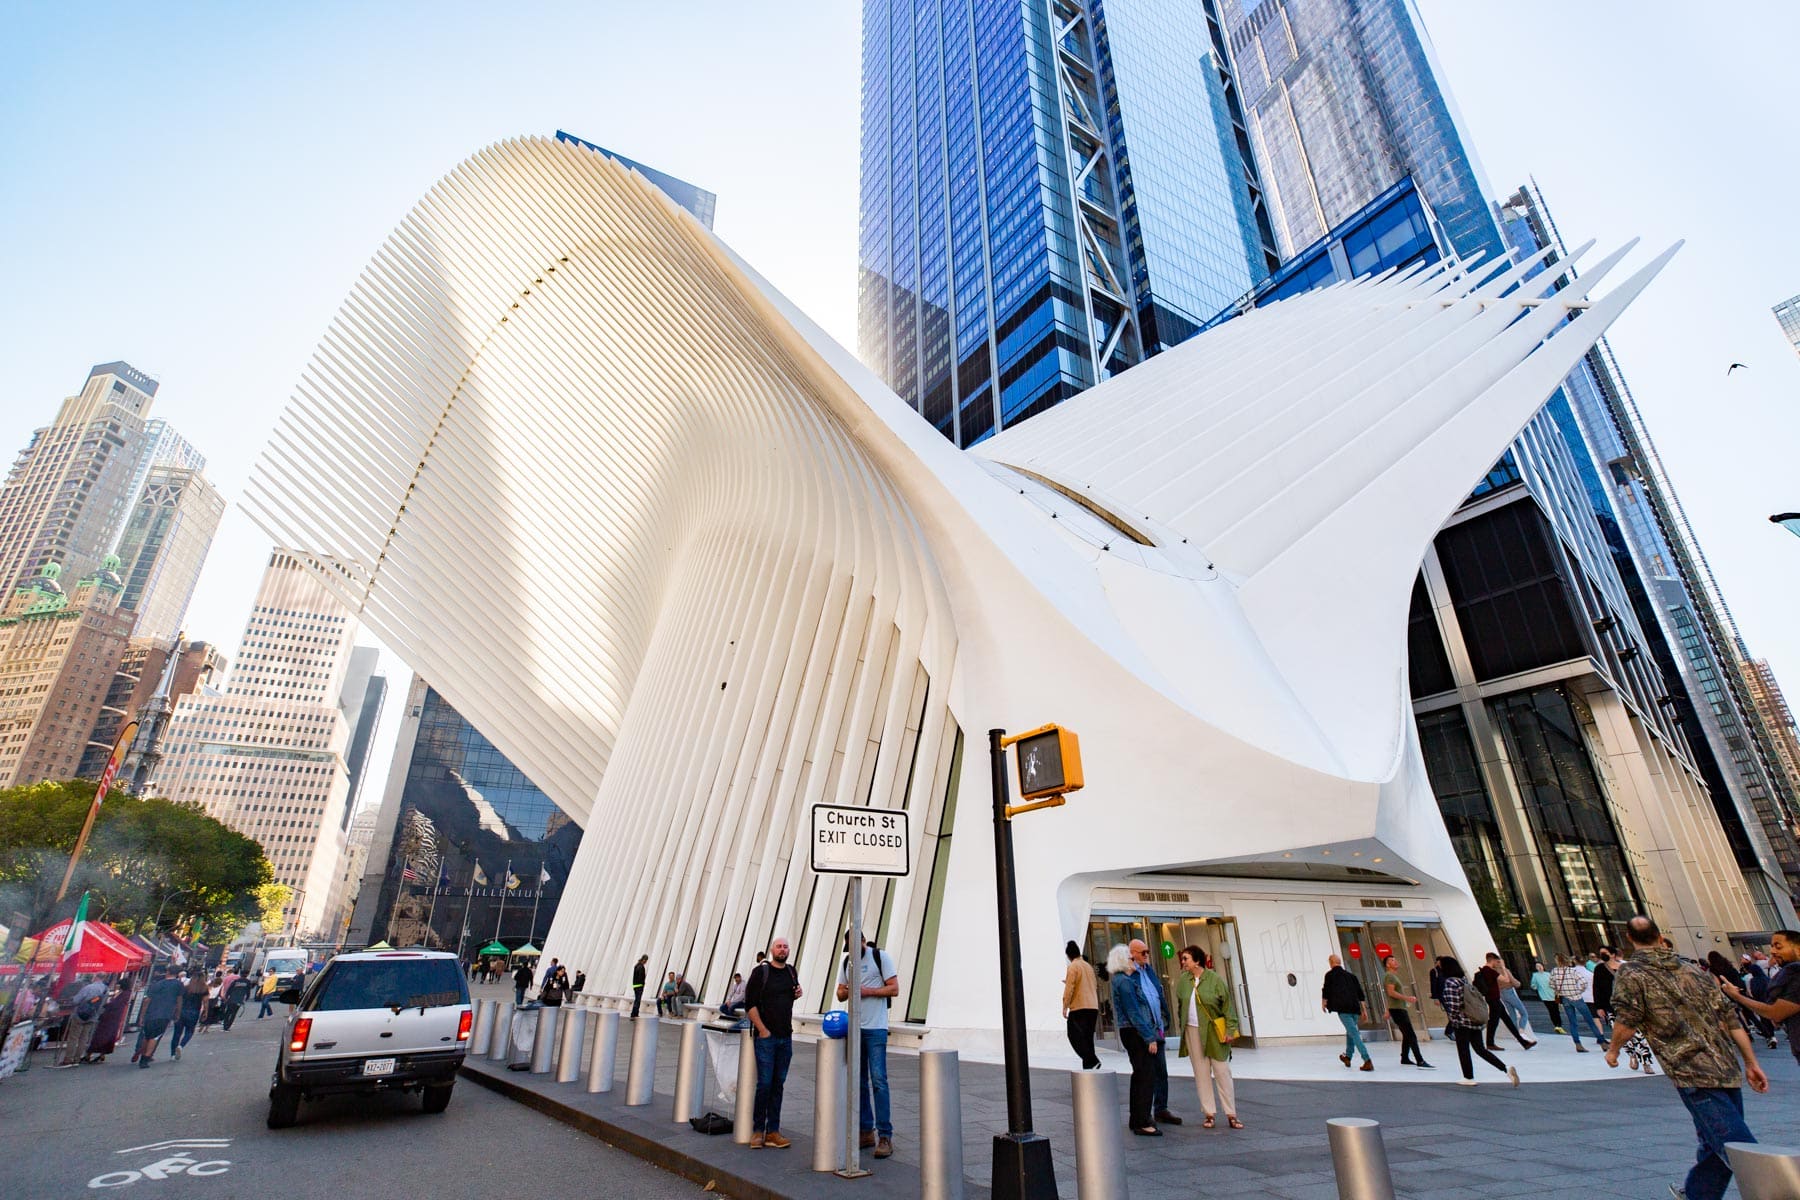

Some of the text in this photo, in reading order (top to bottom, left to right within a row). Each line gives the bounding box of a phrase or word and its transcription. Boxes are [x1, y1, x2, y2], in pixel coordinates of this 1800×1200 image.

[827, 811, 896, 829] Church St
[819, 830, 902, 848] EXIT CLOSED
[425, 886, 544, 898] THE MILLENIUM
